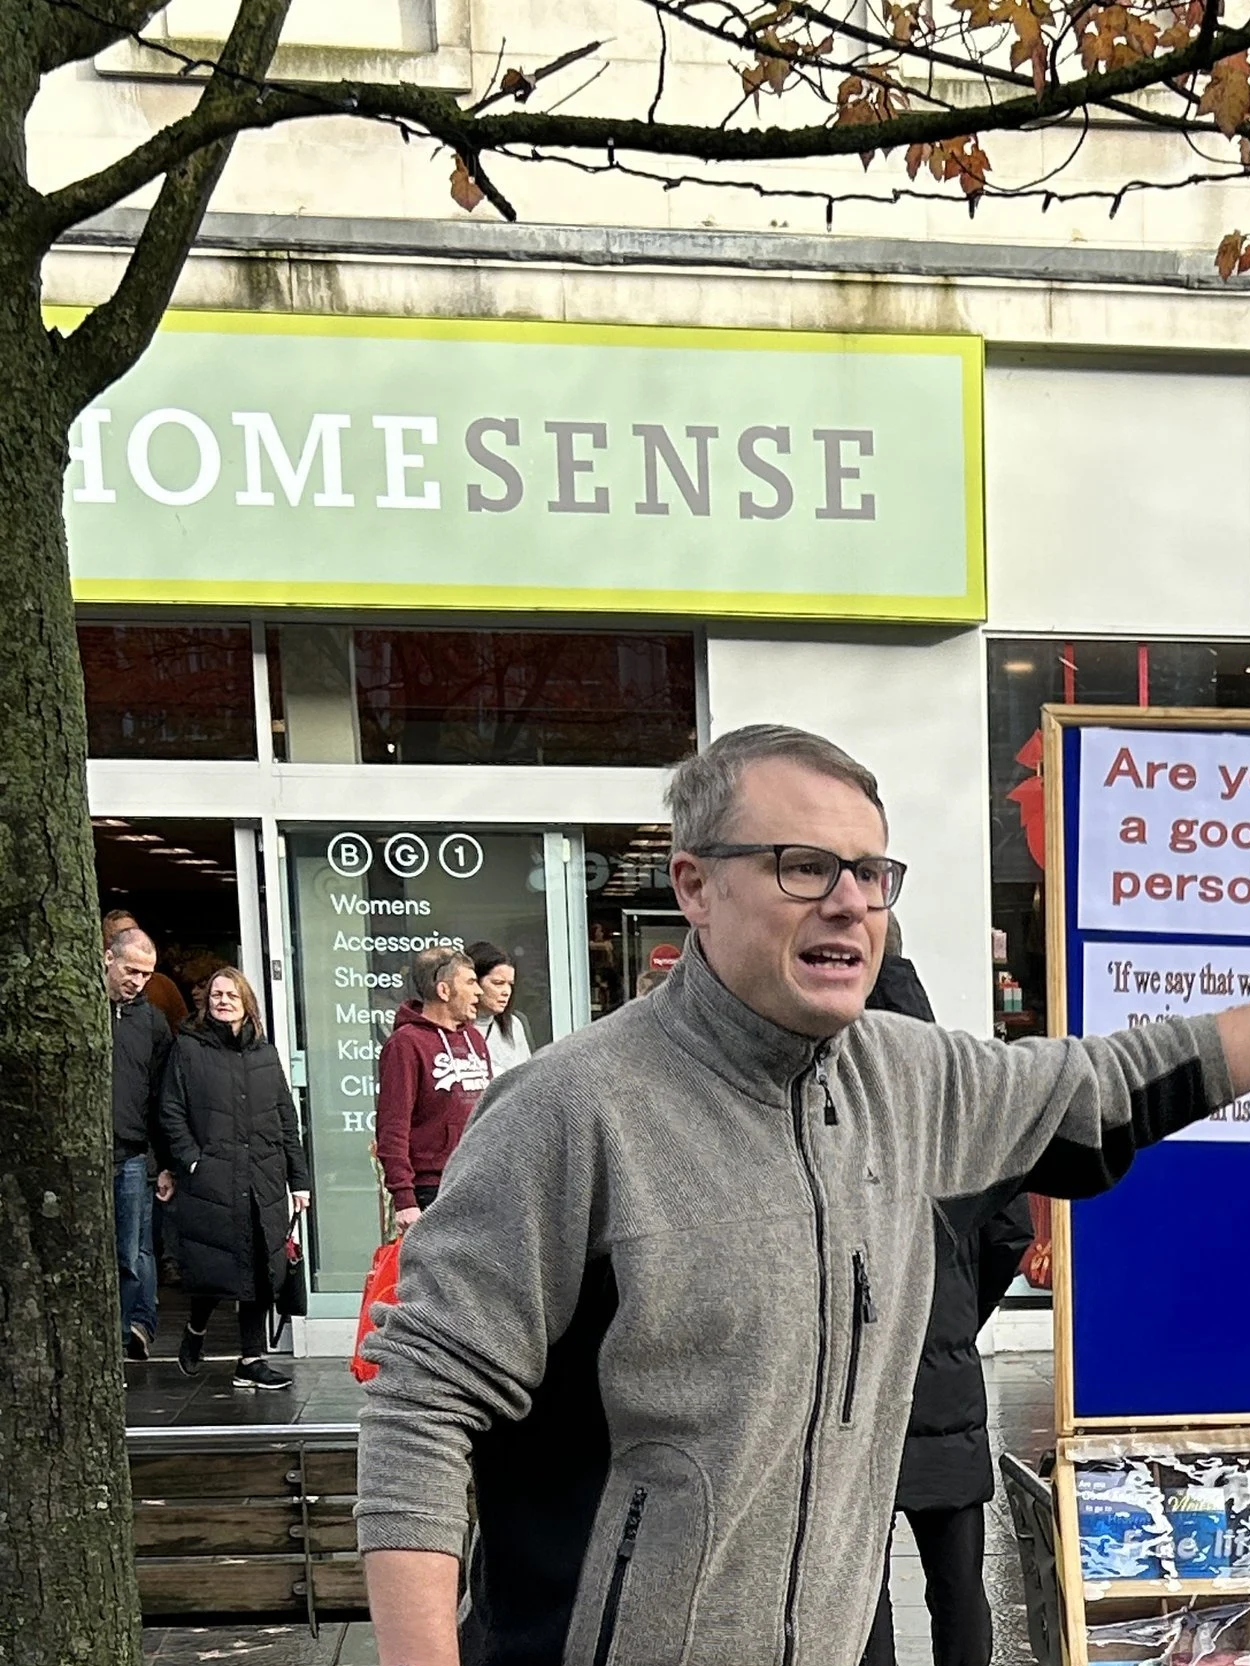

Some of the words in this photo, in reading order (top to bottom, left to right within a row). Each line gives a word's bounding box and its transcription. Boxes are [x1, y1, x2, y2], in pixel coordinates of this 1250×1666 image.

[1104, 748, 1197, 790] Are
[1119, 816, 1147, 844] a
[340, 844, 359, 867] B
[395, 844, 419, 867] G
[454, 846, 465, 867] 1
[330, 894, 430, 915] Womens
[335, 967, 403, 988] Shoes
[1134, 971, 1160, 993] we
[1165, 972, 1195, 1002] say
[1200, 963, 1234, 995] that
[336, 1004, 395, 1024] Mens
